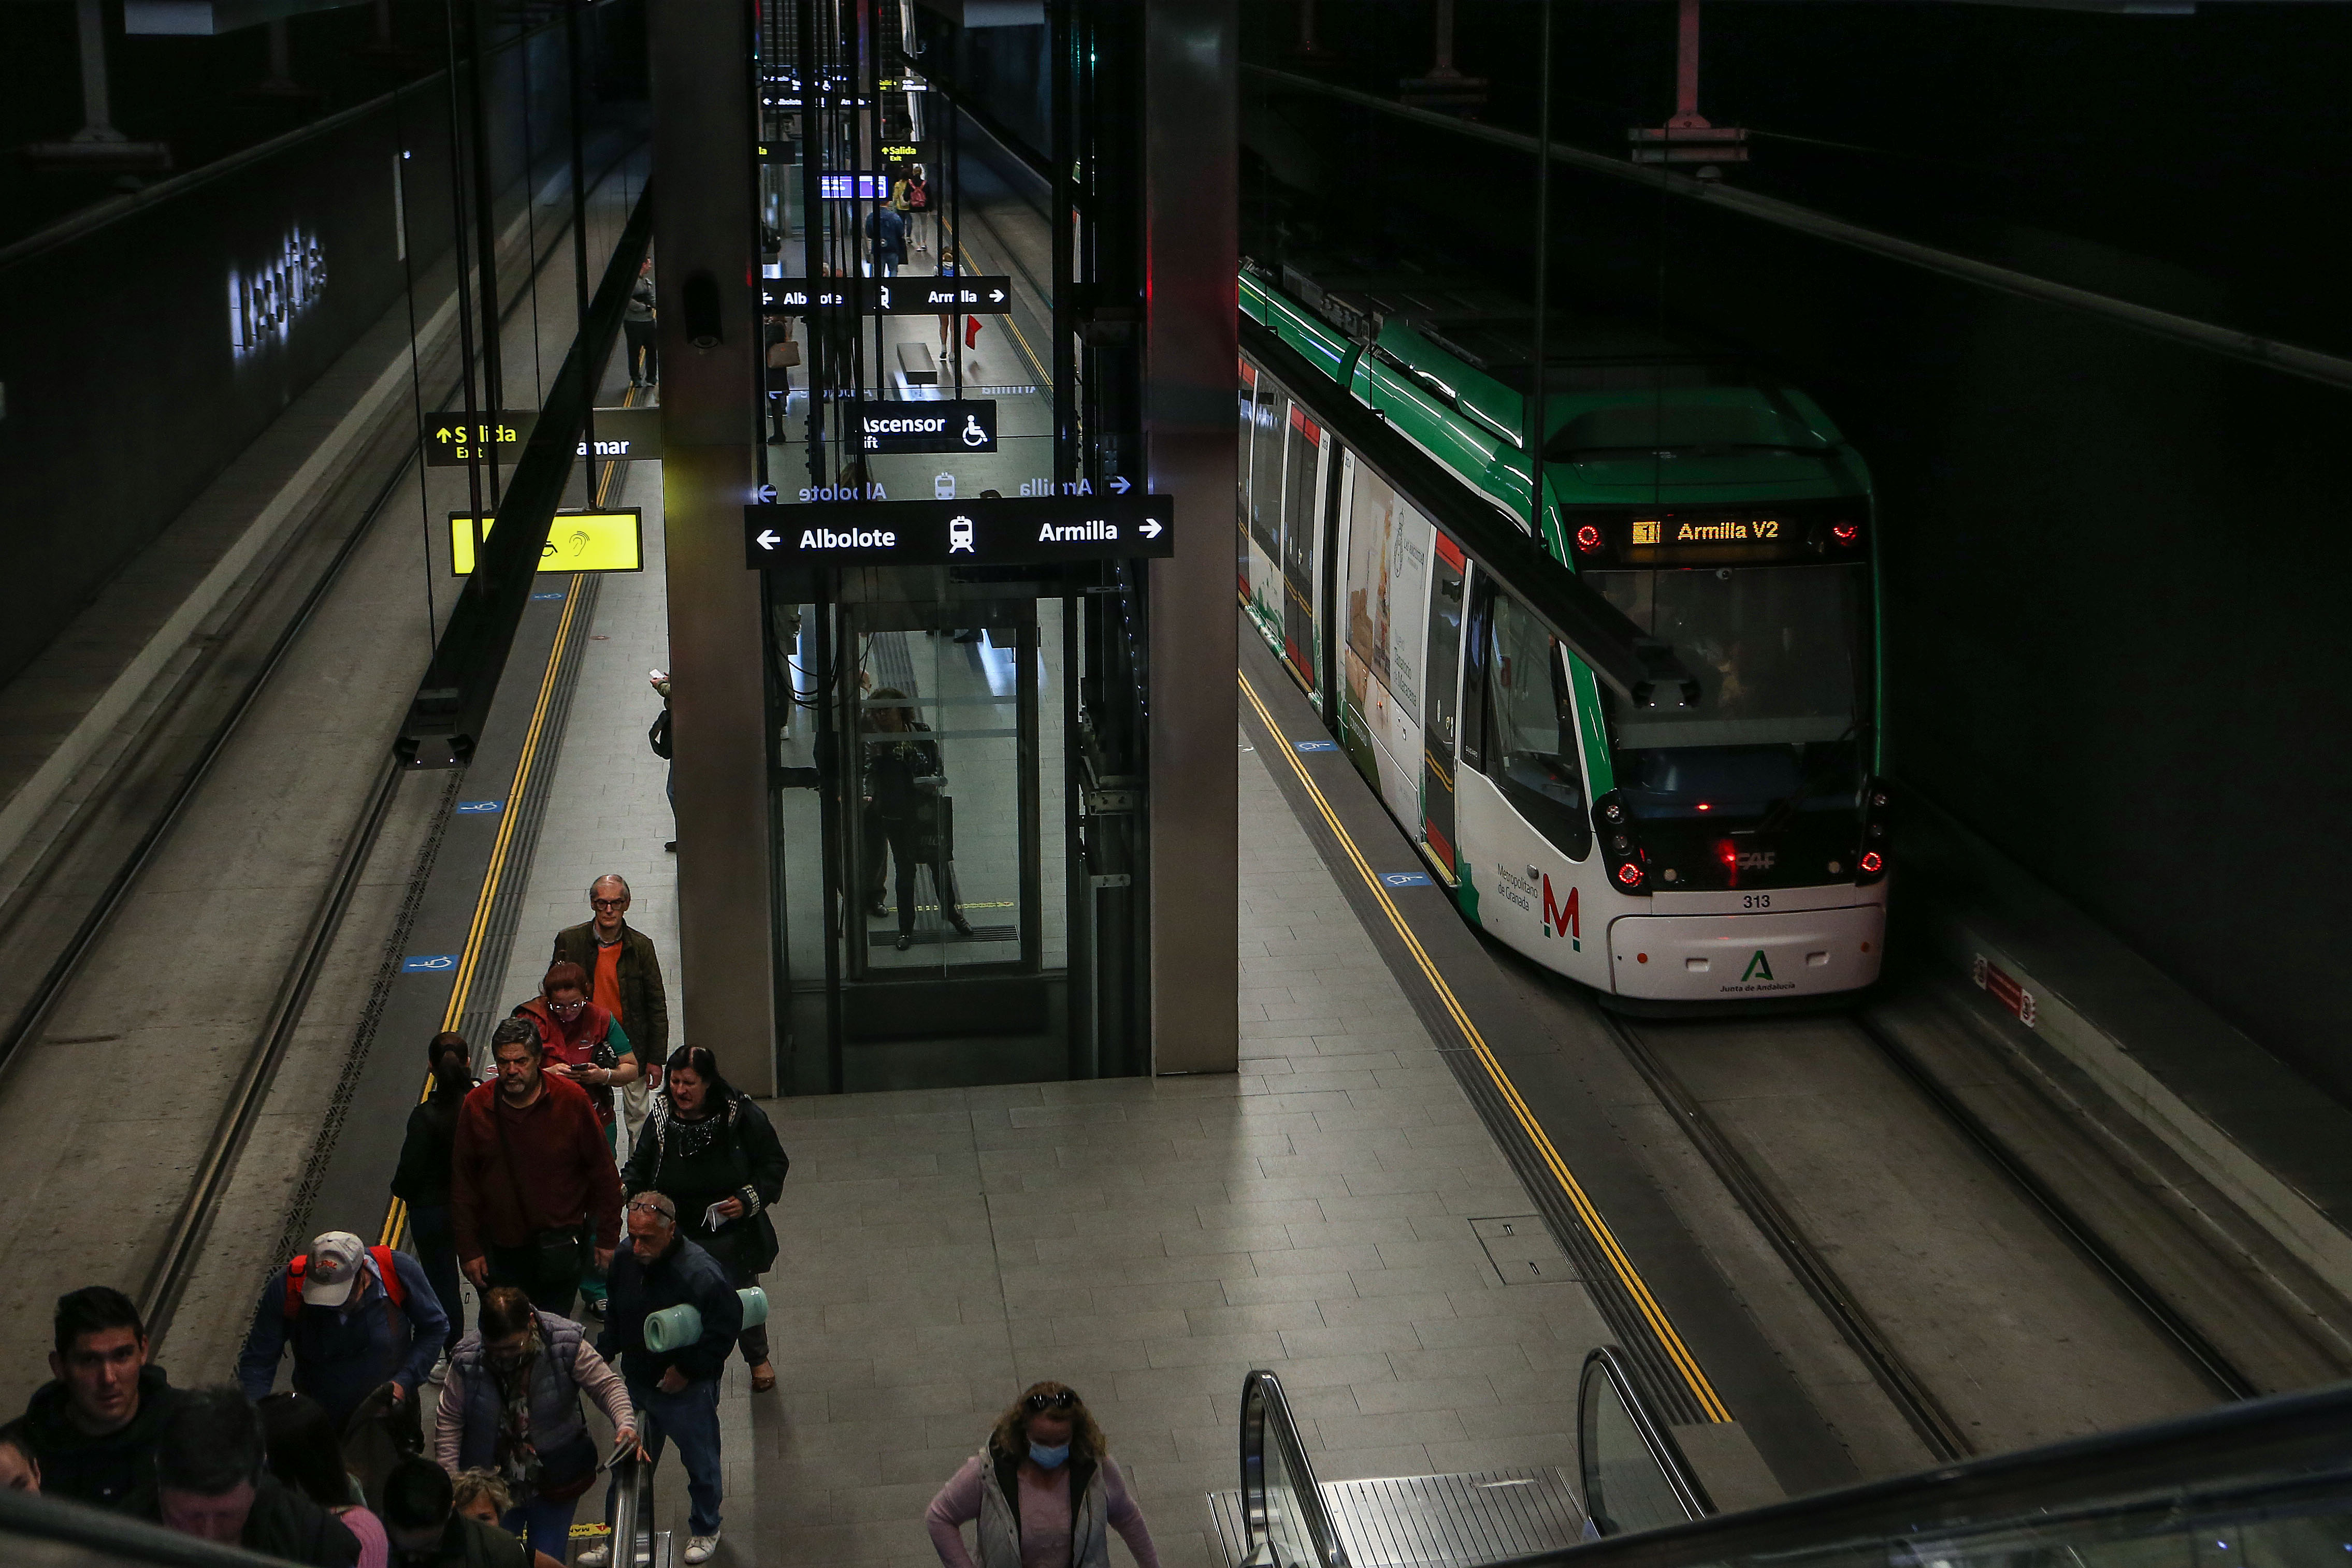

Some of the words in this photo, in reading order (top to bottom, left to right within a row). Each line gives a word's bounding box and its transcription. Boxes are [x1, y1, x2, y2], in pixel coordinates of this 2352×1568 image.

[889, 146, 916, 155] Salida
[784, 292, 843, 305] Albote
[928, 289, 978, 303] Armlla
[455, 425, 517, 443] Slida
[863, 435, 878, 448] ift
[456, 447, 483, 459] Ext
[799, 528, 896, 549] Albolote
[1038, 521, 1118, 542] Armilla
[1677, 522, 1747, 540] Armilla
[1752, 521, 1779, 538] V2
[1498, 863, 1538, 898] Metropolitano
[1498, 881, 1505, 896] de
[1506, 887, 1529, 911] Granada
[1743, 895, 1770, 908] 313
[1543, 873, 1580, 953] M
